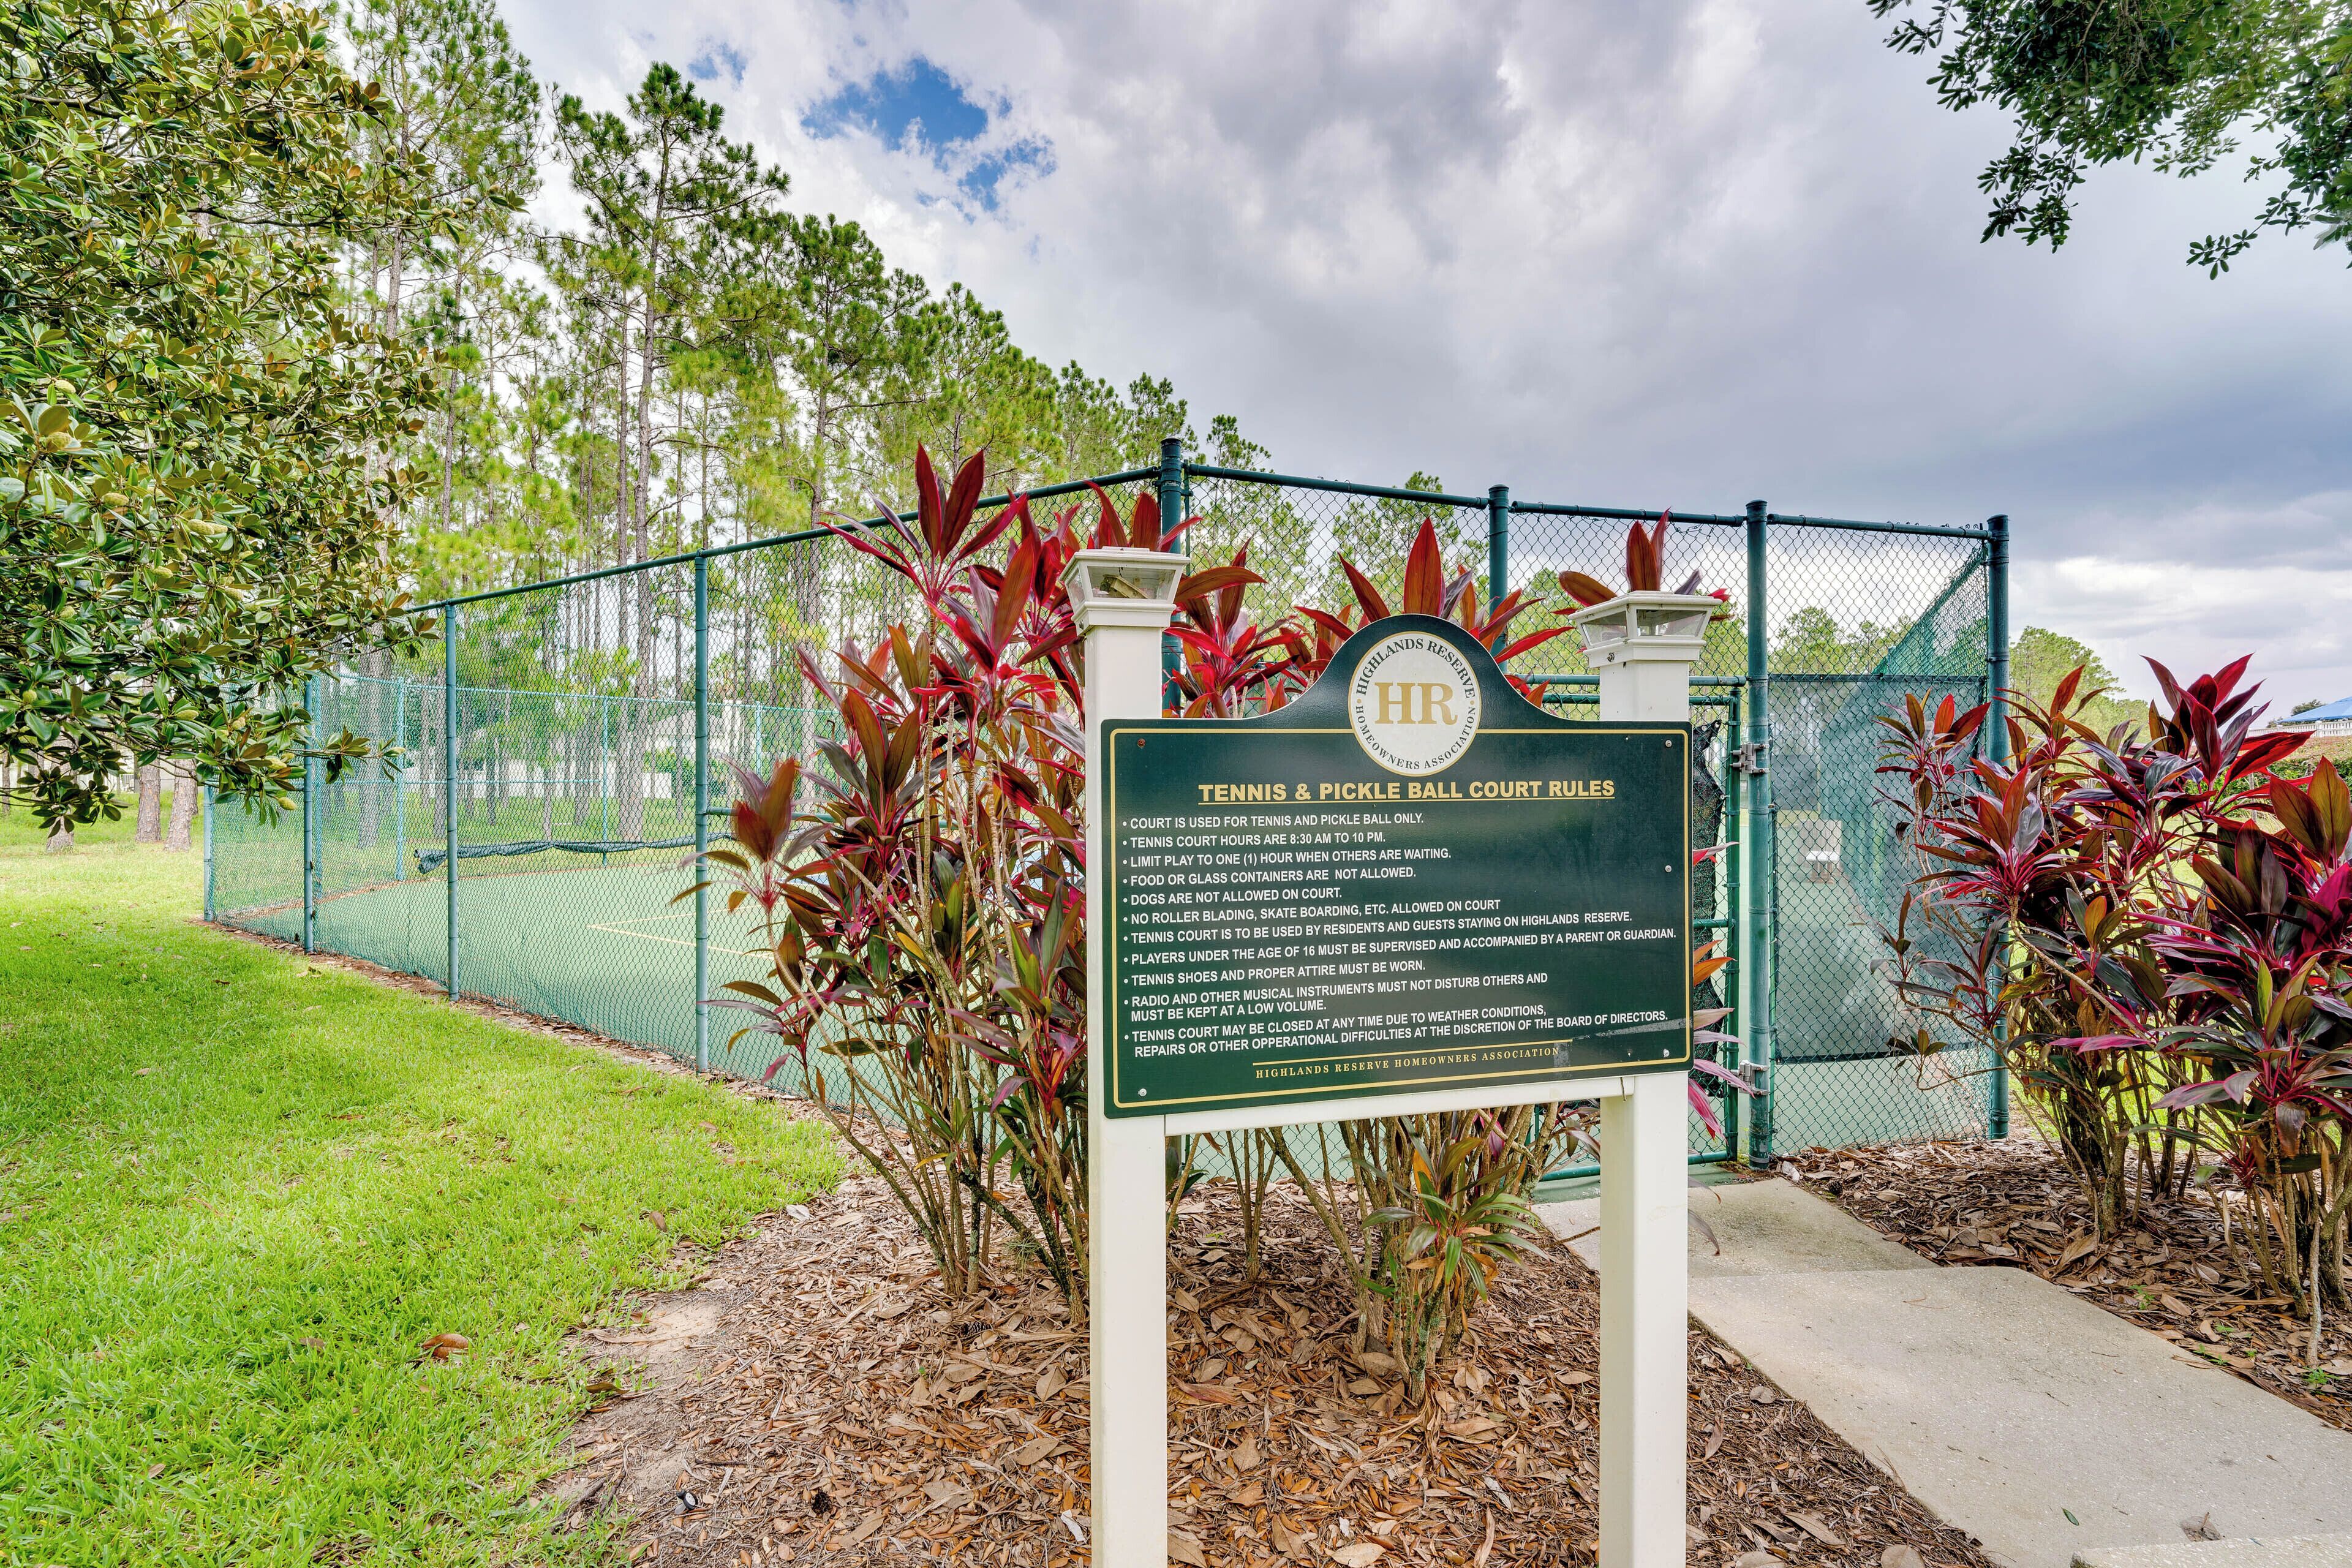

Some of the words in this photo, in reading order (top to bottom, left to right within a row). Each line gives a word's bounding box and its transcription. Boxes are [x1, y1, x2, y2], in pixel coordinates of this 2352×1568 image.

[1356, 638, 1423, 696] HIGHLANDS
[1427, 641, 1476, 698] RESERVE
[1374, 682, 1458, 725] HR
[1356, 706, 1420, 769] HOMEOWNERS
[1424, 707, 1476, 769] ASSOCIATION
[1198, 783, 1287, 802] TENNIS
[1295, 783, 1311, 800] &
[1319, 782, 1400, 799] PICKLE
[1408, 782, 1463, 799] BALL
[1469, 781, 1542, 797] COURT
[1549, 780, 1615, 797] RULES
[1130, 817, 1172, 829] COURT
[1175, 817, 1186, 828] IS
[1189, 816, 1221, 828] USED
[1224, 816, 1248, 827] FOR
[1250, 815, 1291, 826] TENNIS
[1294, 815, 1317, 826] AND
[1321, 814, 1360, 825] PICKLE
[1363, 813, 1392, 824] BALL
[1394, 813, 1423, 824] ONLY.
[1130, 836, 1173, 848] TENNIS
[1176, 835, 1217, 847] COURT
[1220, 834, 1261, 846] HOURS
[1263, 834, 1287, 845] ARE
[1290, 833, 1312, 844] 8:30
[1314, 833, 1331, 843] AM
[1334, 832, 1349, 843] TO
[1352, 832, 1364, 843] 10
[1367, 832, 1385, 842] PM.
[1131, 856, 1161, 867] LIMIT
[1164, 854, 1194, 866] PLAY
[1196, 854, 1213, 865] TO
[1216, 853, 1240, 865] ONE
[1243, 853, 1257, 867] (1)
[1261, 852, 1293, 864] HOUR
[1295, 851, 1329, 862] WHEN
[1332, 850, 1377, 862] OTHERS
[1379, 849, 1401, 860] ARE
[1404, 848, 1451, 859] WAITING.
[1131, 875, 1164, 886] FOOD
[1167, 874, 1185, 885] OR
[1188, 872, 1227, 884] GLASS
[1231, 870, 1303, 883] CONTAINERS
[1305, 869, 1329, 881] ARE
[1335, 869, 1358, 880] NOT
[1360, 867, 1416, 879] ALLOWED.
[1131, 893, 1165, 905] DOGS
[1167, 892, 1193, 904] ARE
[1196, 891, 1220, 903] NOT
[1222, 889, 1279, 902] ALLOWED
[1282, 889, 1298, 900] ON
[1302, 887, 1342, 899] COURT.
[1131, 913, 1148, 924] NO
[1152, 911, 1200, 924] ROLLER
[1203, 909, 1257, 922] BLADING,
[1260, 907, 1297, 919] SKATE
[1300, 905, 1362, 918] BOARDING,
[1365, 903, 1389, 915] ETC.
[1391, 902, 1444, 914] ALLOWED
[1446, 900, 1461, 911] ON
[1464, 899, 1501, 911] COURT
[1131, 931, 1174, 944] TENNIS
[1177, 929, 1218, 941] COURT
[1221, 929, 1232, 940] IS
[1234, 927, 1250, 939] TO
[1253, 927, 1269, 938] BE
[1272, 925, 1303, 937] USED
[1306, 924, 1321, 936] BY
[1324, 922, 1385, 935] RESIDENTS
[1387, 921, 1410, 932] AND
[1412, 919, 1455, 931] GUESTS
[1458, 917, 1501, 929] STAYING
[1504, 916, 1518, 927] ON
[1521, 913, 1579, 926] HIGHLANDS
[1585, 911, 1632, 923] RESERVE.
[1131, 951, 1185, 965] PLAYERS
[1189, 949, 1229, 962] UNDER
[1232, 948, 1255, 960] THE
[1257, 946, 1281, 959] AGE
[1284, 946, 1300, 957] OF
[1303, 945, 1315, 956] 16
[1318, 943, 1349, 956] MUST
[1351, 943, 1366, 954] BE
[1369, 940, 1436, 953] SUPERVISED
[1438, 938, 1461, 949] AND
[1463, 935, 1538, 948] ACCOMPANIED
[1540, 933, 1555, 944] BY
[1556, 933, 1564, 944] A
[1566, 931, 1604, 943] PARENT
[1607, 930, 1621, 941] OR
[1623, 928, 1676, 940] GUARDIAN.
[1131, 973, 1174, 986] TENNIS
[1177, 971, 1218, 984] SHOES
[1220, 970, 1245, 981] AND
[1248, 967, 1295, 979] PROPER
[1297, 965, 1336, 977] ATTIRE
[1339, 963, 1370, 974] MUST
[1372, 962, 1387, 973] BE
[1389, 960, 1425, 972] WORN.
[1132, 994, 1169, 1007] RADIO
[1172, 993, 1197, 1005] AND
[1200, 990, 1240, 1003] OTHER
[1243, 987, 1294, 1001] MUSICAL
[1297, 982, 1374, 998] INSTRUMENTS
[1378, 981, 1408, 993] MUST
[1410, 979, 1432, 991] NOT
[1434, 976, 1480, 989] DISTURB
[1482, 974, 1524, 986] OTHERS
[1526, 973, 1548, 984] AND
[1131, 1009, 1164, 1022] MUST
[1167, 1008, 1183, 1020] BE
[1187, 1006, 1218, 1019] KEPT
[1219, 1005, 1235, 1016] AT
[1237, 1004, 1245, 1016] A
[1248, 1002, 1274, 1014] LOW
[1276, 1000, 1327, 1012] VOLUME.
[1131, 1028, 1175, 1042] TENNIS
[1178, 1025, 1219, 1039] COURT
[1222, 1024, 1246, 1036] MAY
[1249, 1023, 1265, 1035] BE
[1267, 1020, 1313, 1033] CLOSED
[1316, 1019, 1330, 1030] AT
[1332, 1017, 1355, 1029] ANY
[1357, 1015, 1383, 1027] TIME
[1386, 1013, 1408, 1025] DUE
[1410, 1012, 1425, 1023] TO
[1427, 1009, 1479, 1022] WEATHER
[1481, 1005, 1546, 1019] CONDITIONS,
[1135, 1043, 1186, 1058] REPAIRS
[1189, 1042, 1207, 1054] OR
[1209, 1039, 1249, 1052] OTHER
[1252, 1033, 1338, 1049] OPPERATIONAL
[1341, 1028, 1412, 1043] DIFFICULTIES
[1414, 1027, 1428, 1038] AT
[1430, 1025, 1451, 1036] THE
[1453, 1020, 1515, 1035] DISCRETION
[1518, 1019, 1532, 1030] OF
[1534, 1018, 1554, 1029] THE
[1556, 1016, 1592, 1028] BOARD
[1594, 1014, 1608, 1025] OF
[1610, 1010, 1668, 1024] DIRECTORS.
[1256, 1065, 1329, 1079] HIGHLANDS
[1335, 1060, 1389, 1072] RESERVE
[1394, 1053, 1476, 1068] HOMEOWNERS
[1482, 1047, 1559, 1061] ASSOCIATION
